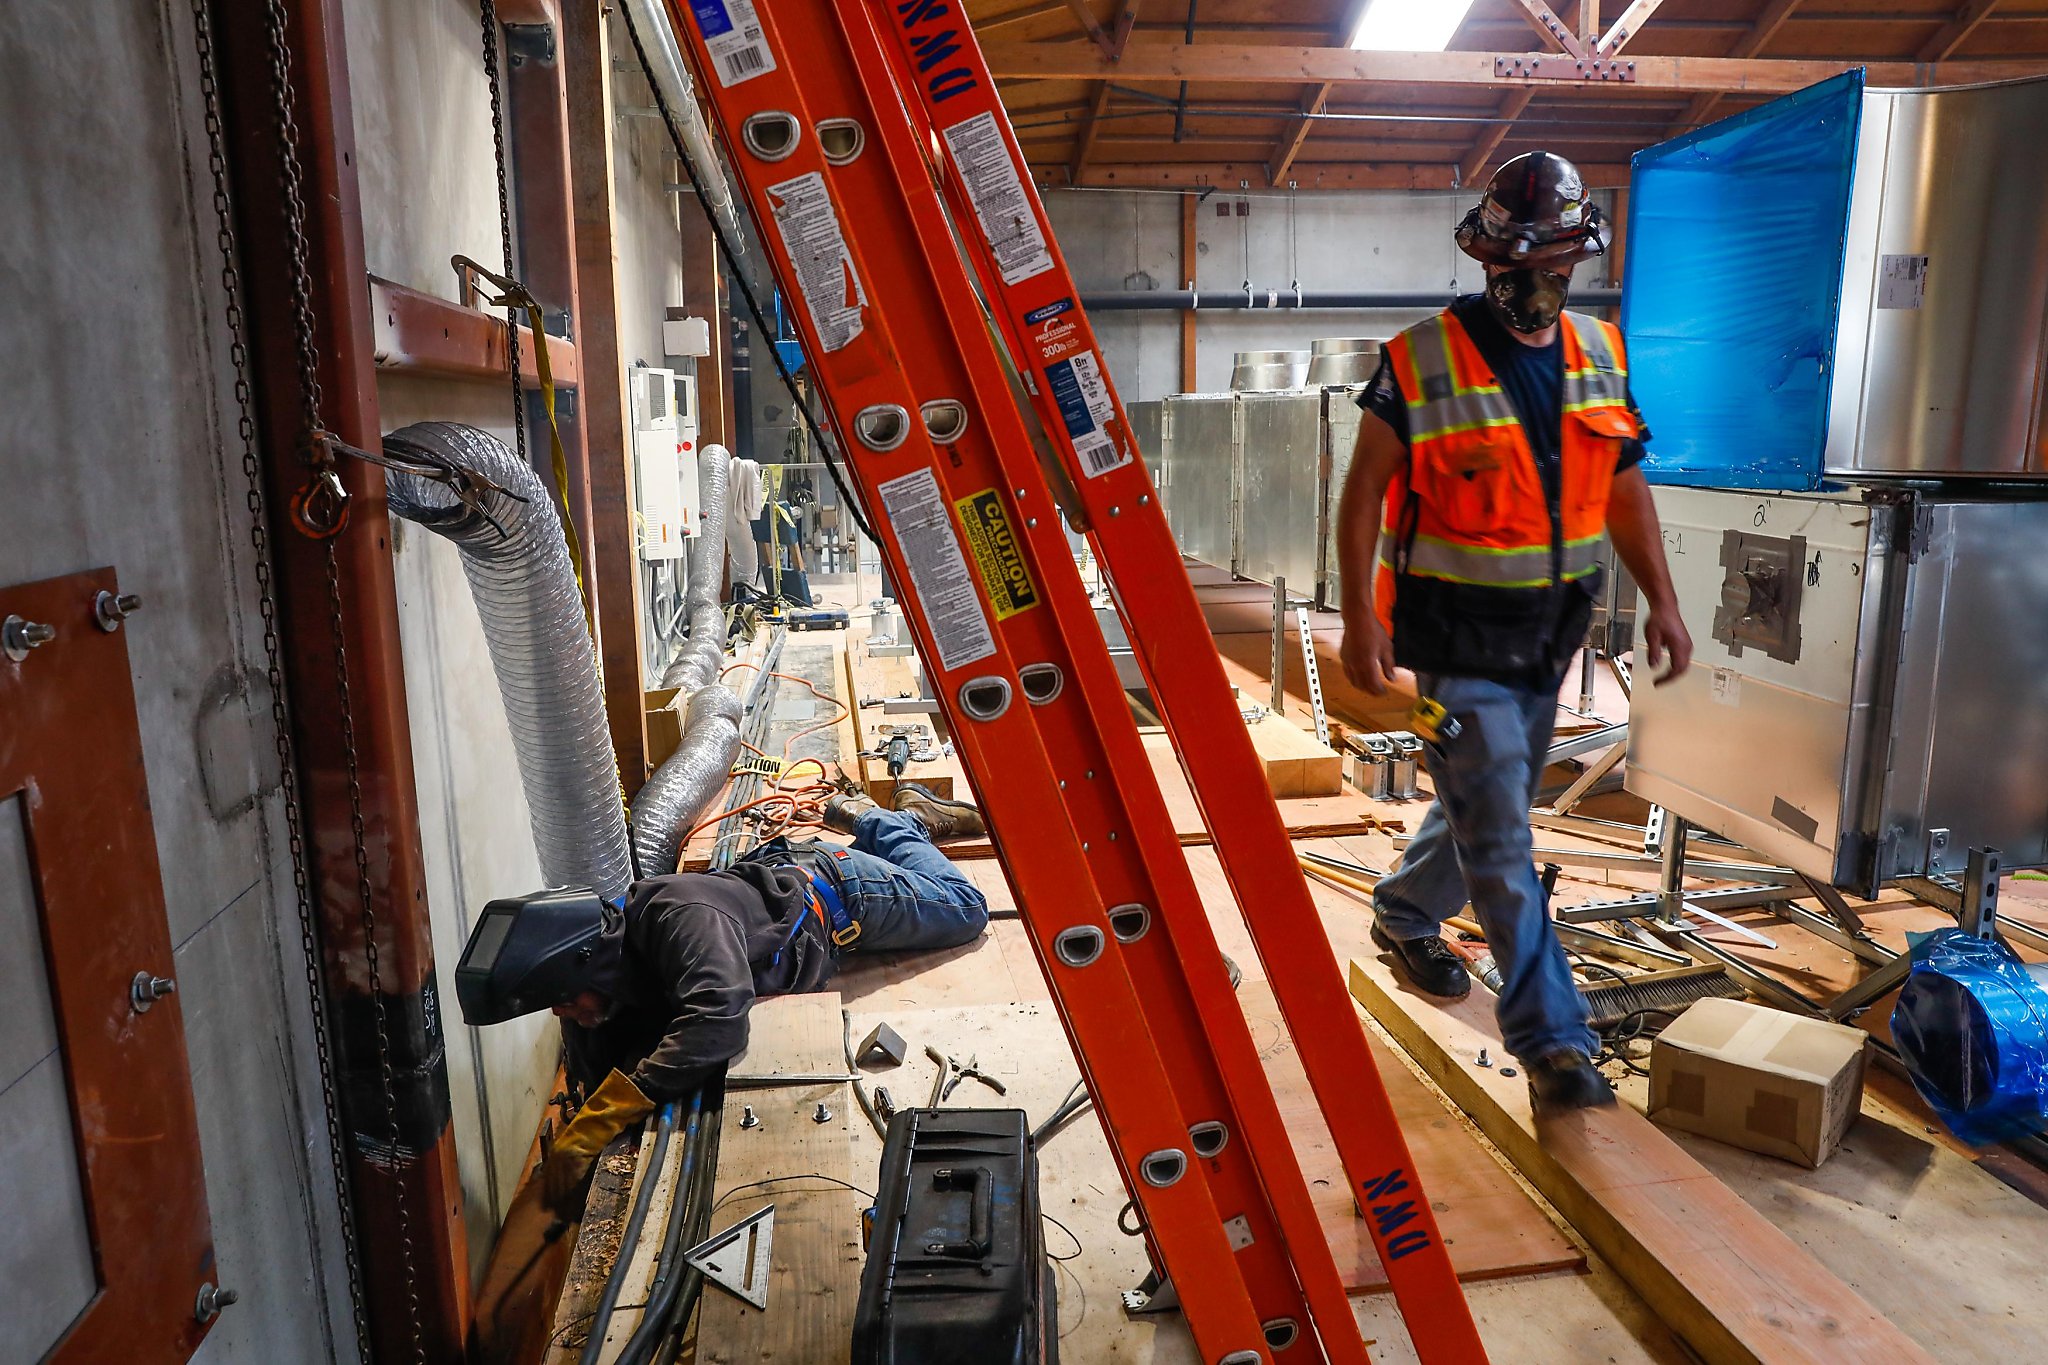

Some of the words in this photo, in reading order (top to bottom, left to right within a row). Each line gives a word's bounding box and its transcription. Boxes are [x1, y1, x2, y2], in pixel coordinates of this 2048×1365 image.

[1035, 322, 1076, 343] PROFESSIONAL
[967, 503, 978, 521] THIS
[973, 521, 990, 552] LADDER
[985, 502, 1030, 597] CAUTION
[959, 505, 978, 543] DESIGNED
[975, 542, 985, 559] FOR
[981, 559, 999, 597] SEPARATE
[995, 597, 1007, 612] USE
[985, 552, 1003, 586] SECTION
[998, 585, 1006, 594] IS
[1001, 593, 1012, 609] NOT
